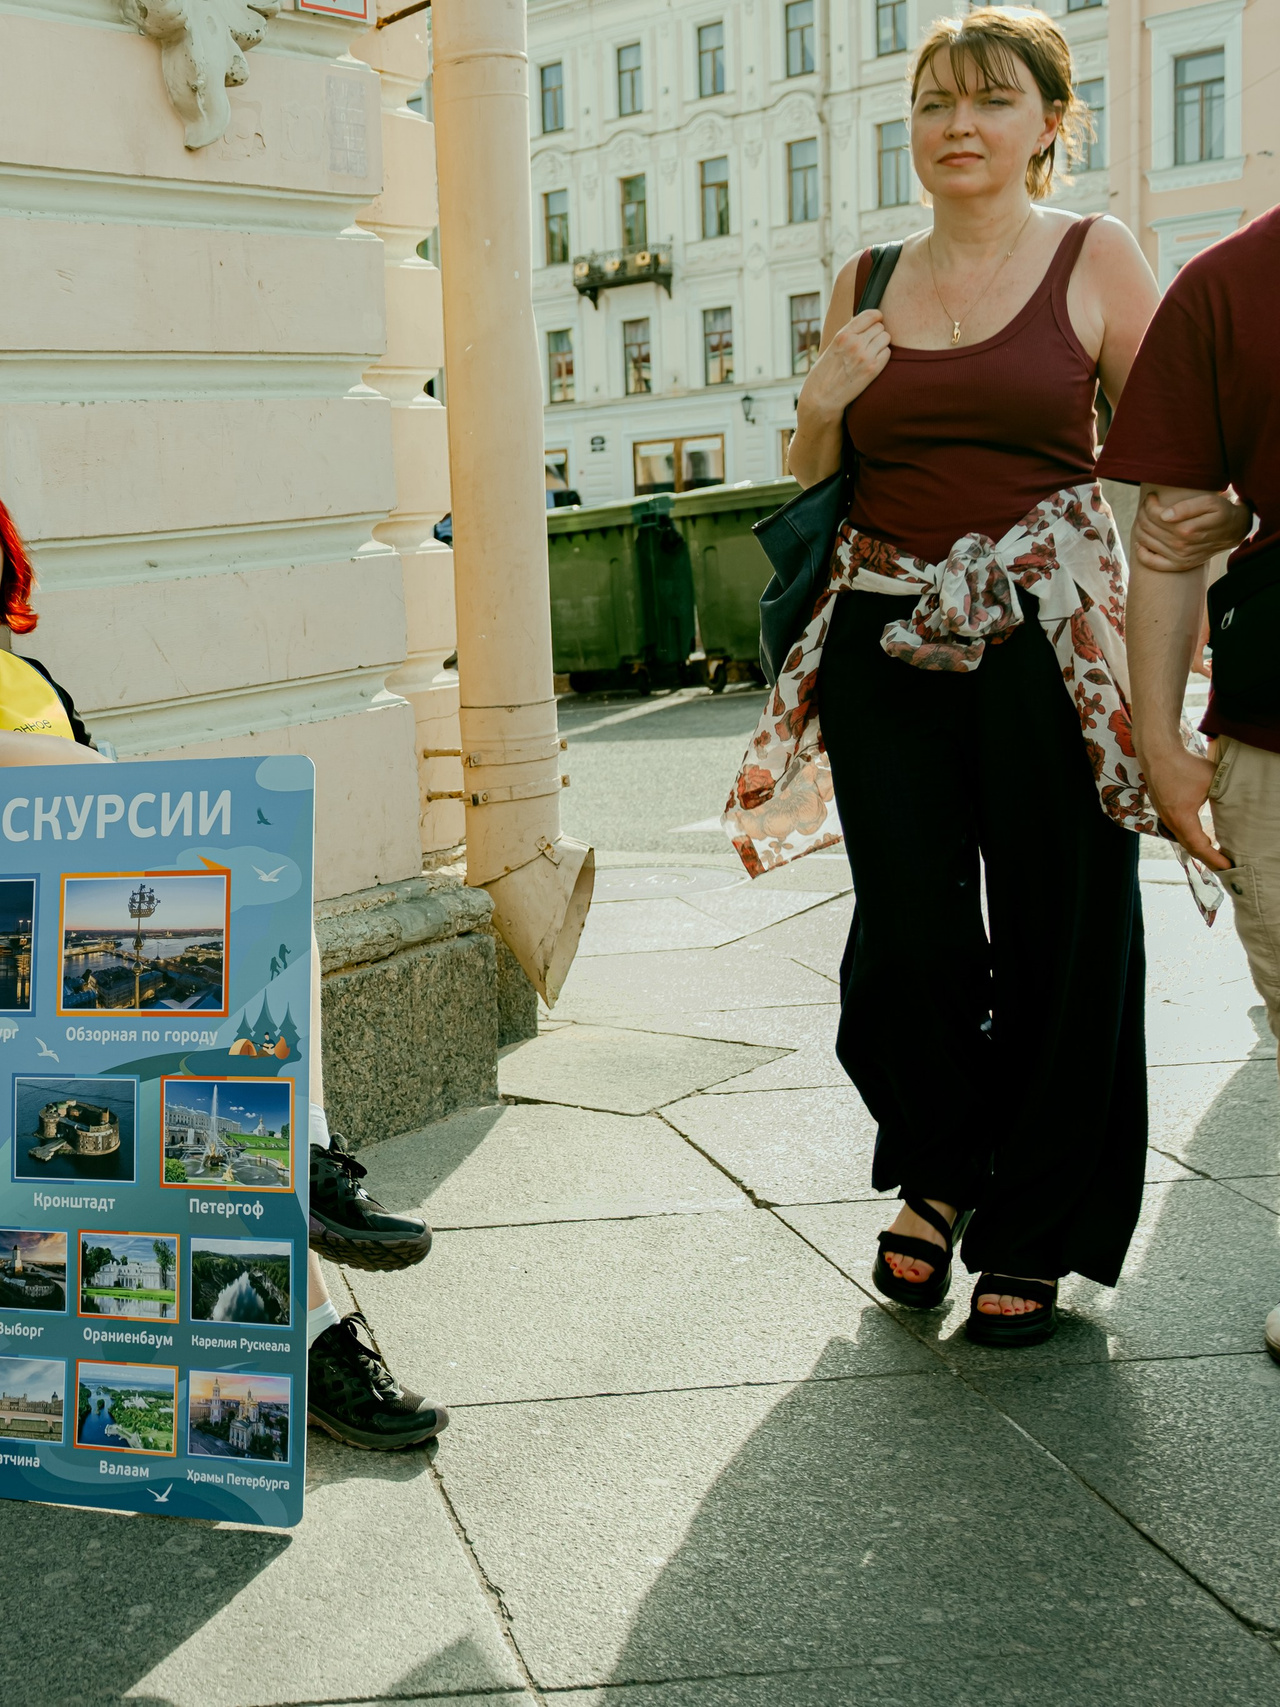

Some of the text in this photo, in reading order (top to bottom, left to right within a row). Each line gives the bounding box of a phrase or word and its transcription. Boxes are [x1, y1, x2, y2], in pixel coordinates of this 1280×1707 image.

[66, 1027, 218, 1046] Обзорная по городу
[34, 1193, 115, 1212] Кронштадт
[190, 1199, 263, 1219] Петергоф
[84, 1328, 172, 1348] Ораниенбаум
[192, 1335, 290, 1352] Карелия Рускеала
[100, 1461, 149, 1477] Валаам
[187, 1470, 289, 1491] Храмы Петербурга
